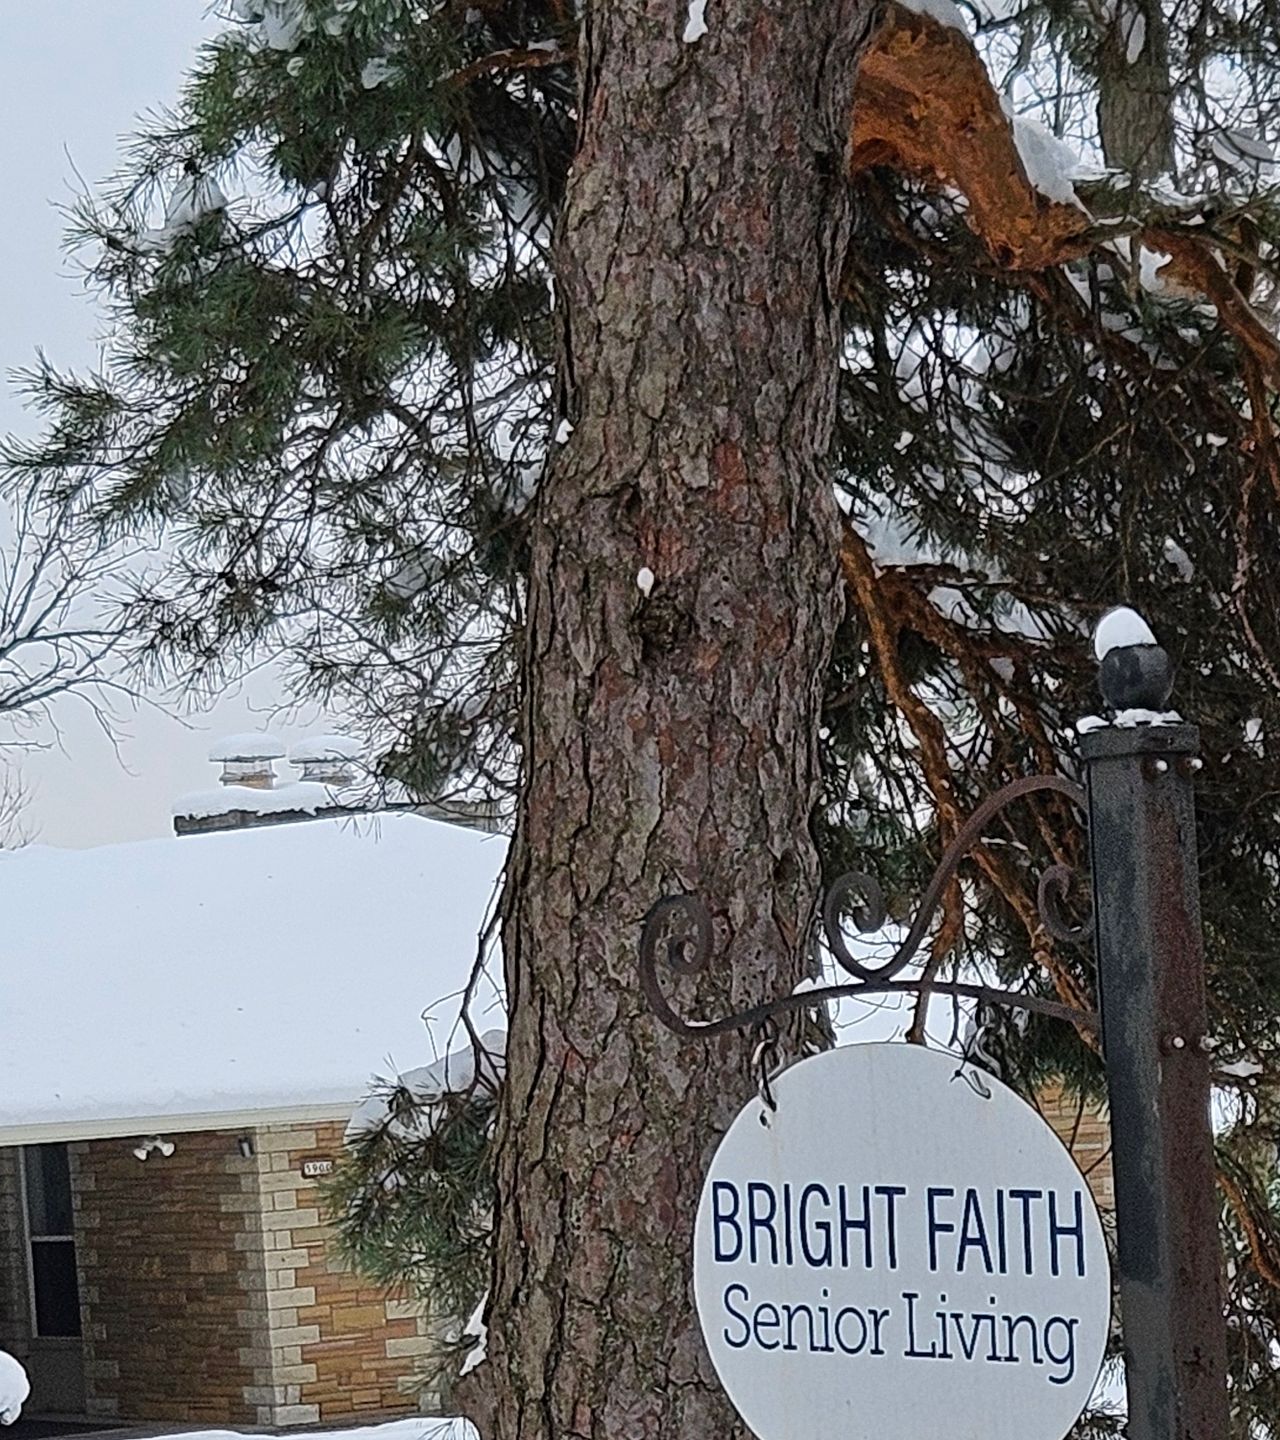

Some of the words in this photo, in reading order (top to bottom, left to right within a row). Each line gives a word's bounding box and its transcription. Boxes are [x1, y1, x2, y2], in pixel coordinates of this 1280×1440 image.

[711, 1180, 907, 1269] BRIGHT
[926, 1187, 1086, 1277] FAITH
[723, 1283, 891, 1356] Senior
[901, 1291, 1080, 1385] Living
